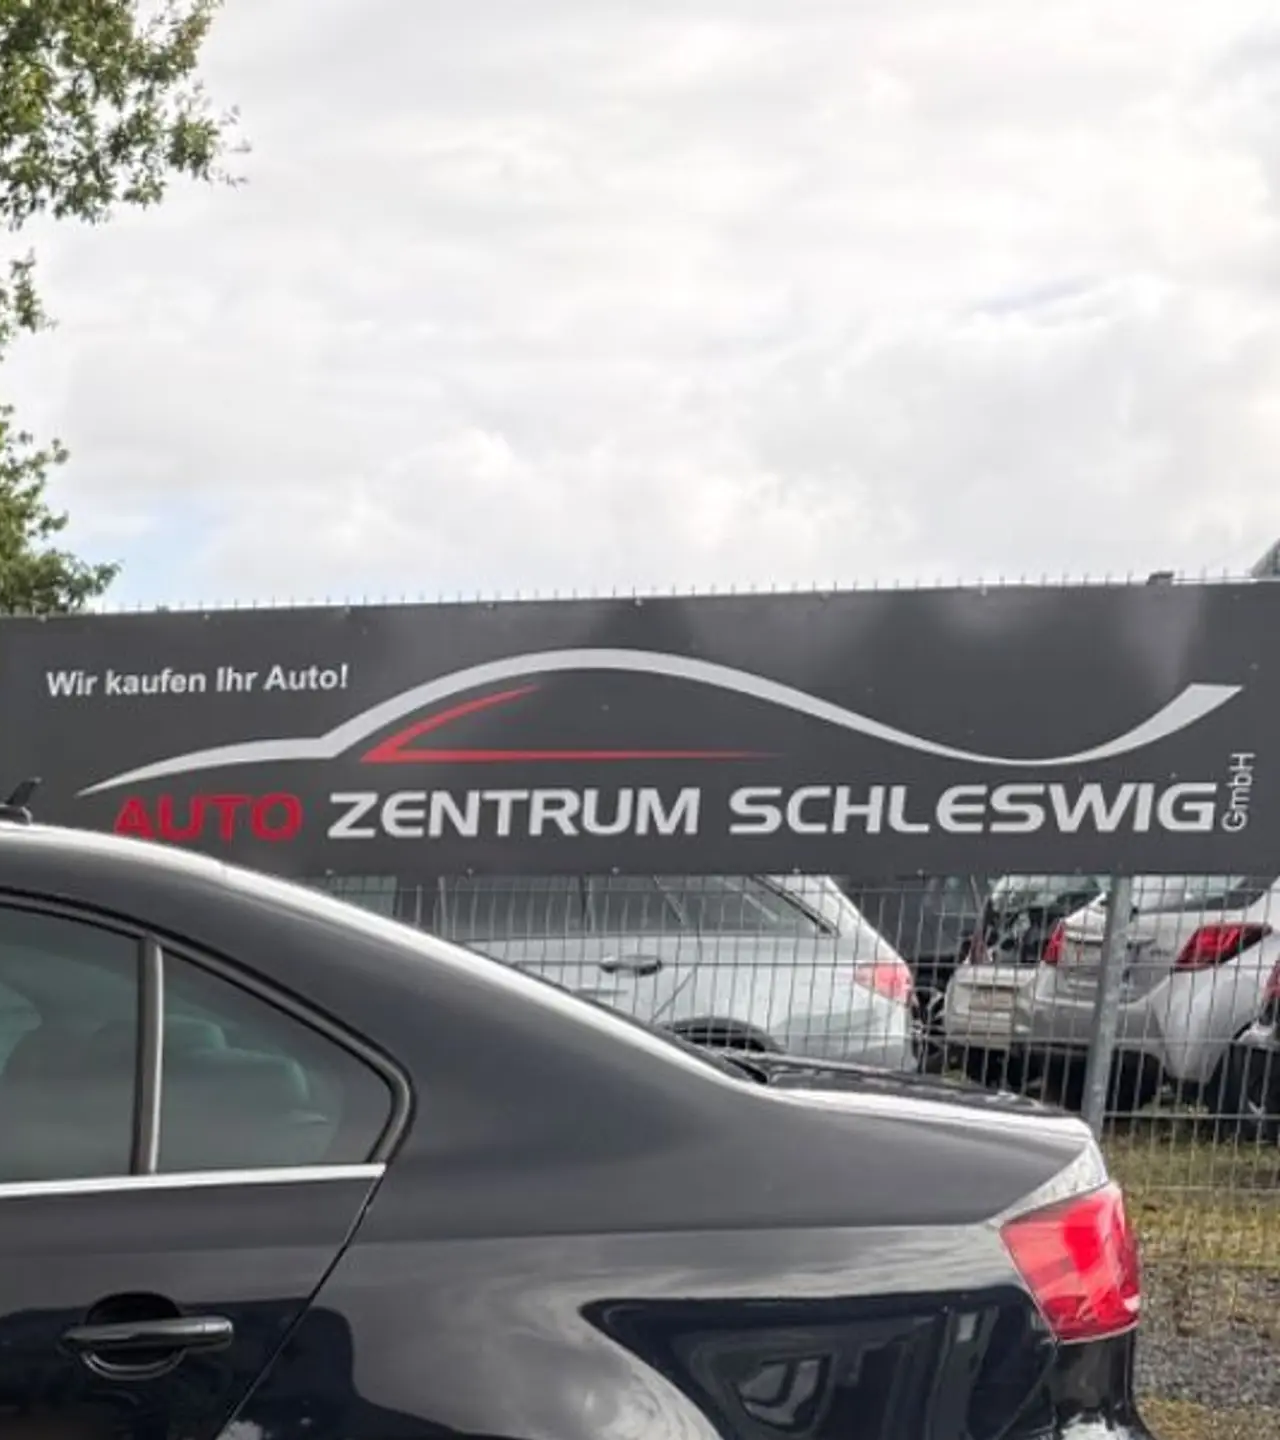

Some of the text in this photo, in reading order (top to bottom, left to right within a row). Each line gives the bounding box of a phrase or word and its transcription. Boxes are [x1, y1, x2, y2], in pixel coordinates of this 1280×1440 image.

[46, 663, 349, 696] Wir kaufen Ihr Auto!
[114, 782, 1218, 841] AUTO ZENTRUM SCHLESWIG
[1221, 752, 1256, 832] GmbH
